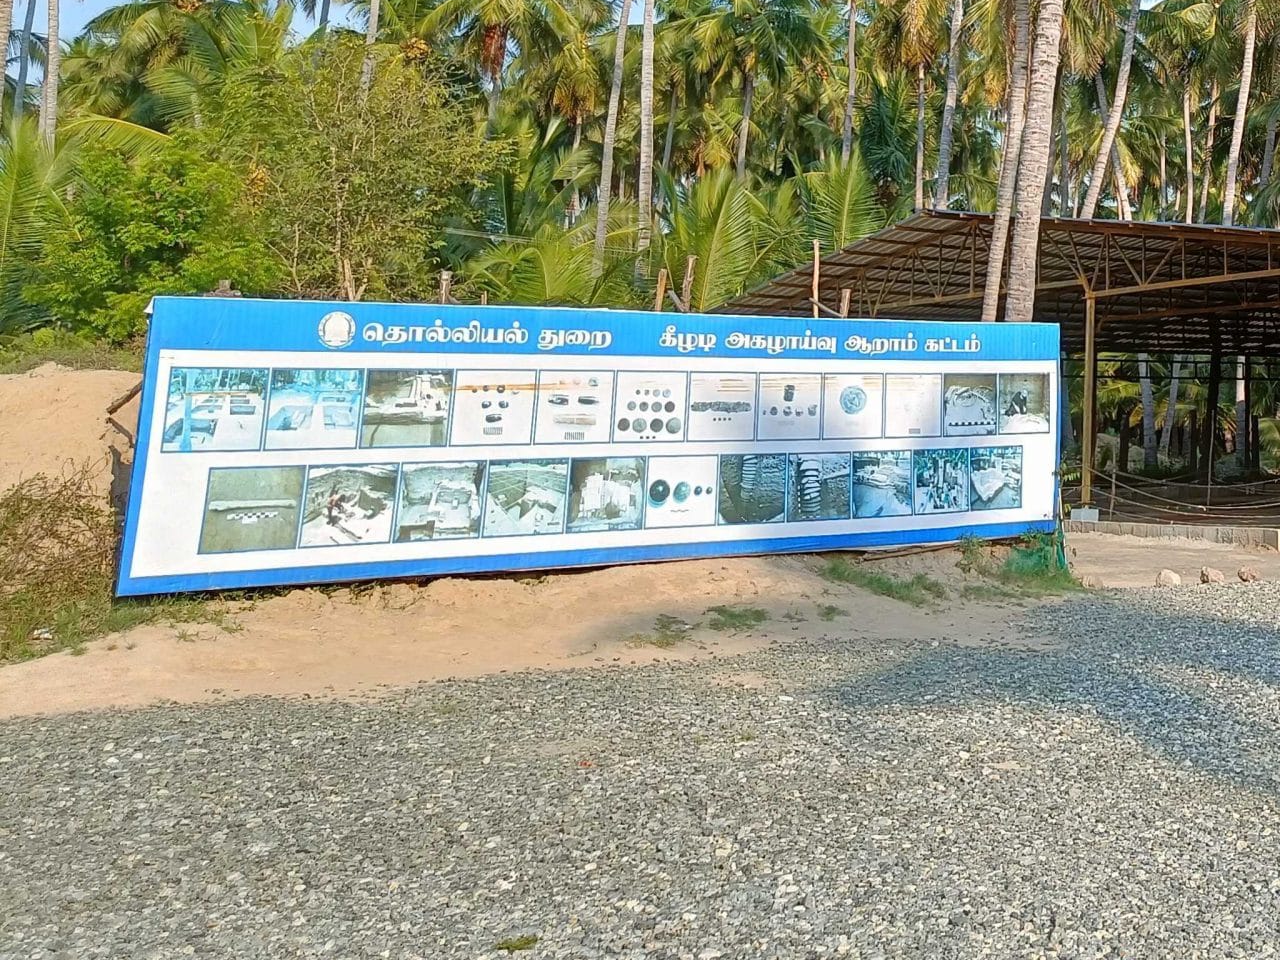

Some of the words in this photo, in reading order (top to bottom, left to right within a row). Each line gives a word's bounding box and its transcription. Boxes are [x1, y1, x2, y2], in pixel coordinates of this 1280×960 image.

[362, 319, 528, 345] தொல்லியல்
[537, 327, 612, 351] துறை
[659, 325, 717, 354] கீழடி
[725, 329, 836, 354] அகழாய்வு
[844, 332, 918, 356] ஆறாம்
[924, 333, 981, 353] கட்டம்
